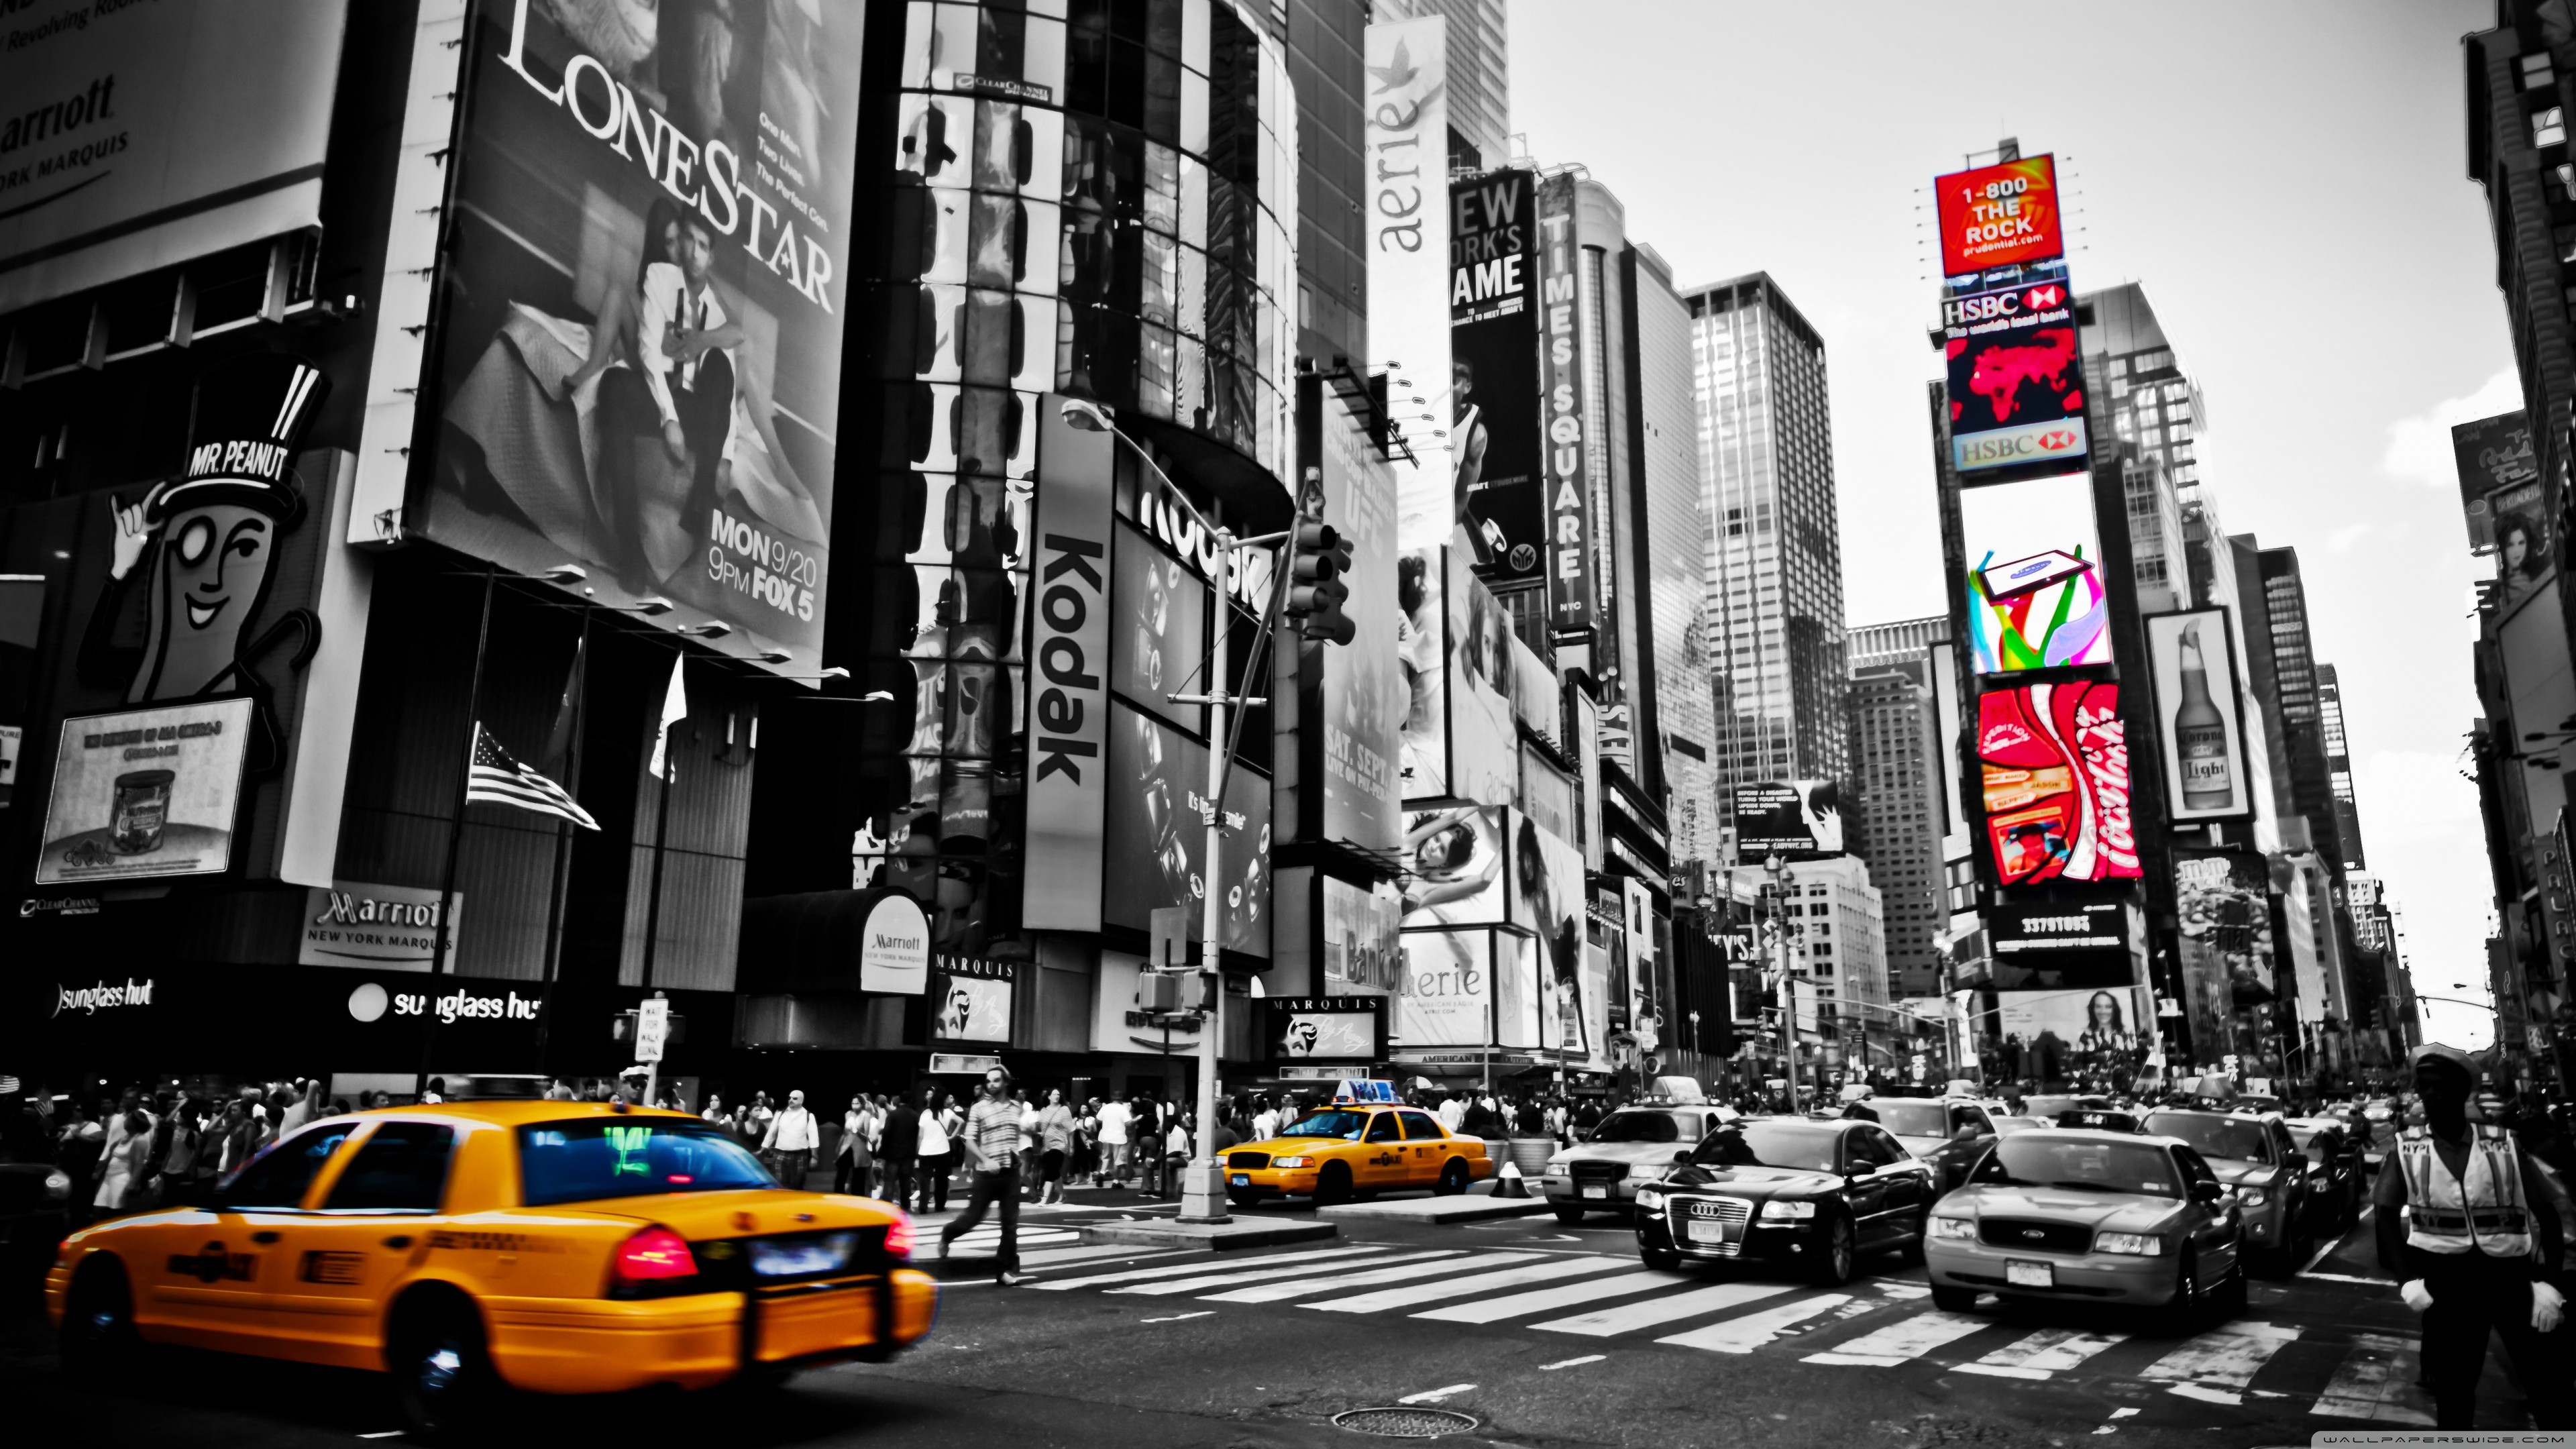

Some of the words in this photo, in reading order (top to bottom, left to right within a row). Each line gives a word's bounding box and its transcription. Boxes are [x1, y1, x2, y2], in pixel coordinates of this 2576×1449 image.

[7, 7, 89, 52] Revolving
[0, 74, 115, 153] arriott
[759, 111, 779, 138] One
[0, 164, 31, 193] ORK
[37, 131, 128, 178] MARQUIS
[497, 0, 833, 315] LONESTAR
[757, 134, 778, 163] Two
[756, 160, 775, 186] The
[1376, 99, 1422, 254] aerie
[1962, 177, 2027, 203] 1-800
[1455, 178, 1520, 236] EW
[1972, 198, 2021, 222] THE
[1450, 225, 1523, 268] ORK'S
[1963, 233, 2043, 258] prudential.com
[1966, 216, 2033, 244] ROCK
[1452, 254, 1524, 306] AME
[1543, 214, 1574, 366] TIMES
[1945, 292, 2019, 325] HSBC
[1946, 326, 1968, 339] The
[2011, 313, 2038, 328] local
[2040, 308, 2070, 323] bank
[188, 442, 220, 477] MR.
[222, 440, 288, 481] PEANUT
[1962, 434, 2035, 463] HSBC
[1550, 384, 1582, 579] SQUARE
[711, 508, 770, 566] MON
[771, 541, 817, 588] 9/20
[708, 545, 750, 594] 9PM
[1560, 601, 1582, 612] NYC
[1036, 533, 1104, 786] Kodak
[1326, 723, 1354, 765] SAT.
[1597, 705, 1630, 773] EY'S
[315, 891, 452, 928] Marriot
[307, 929, 341, 942] NEW
[345, 931, 384, 946] YORK
[388, 935, 452, 951] MARQUS
[871, 933, 920, 951] Marriott
[936, 953, 1013, 977] MARQUIS
[62, 980, 123, 1016] sunglass
[125, 977, 154, 1005] hut
[507, 991, 542, 1019] hu
[1274, 999, 1377, 1010] MARQUIS
[1287, 1017, 1318, 1040] Come
[1311, 1014, 1336, 1040] Fly
[1334, 1022, 1370, 1053] Away
[1421, 1055, 1472, 1063] AMERICAN
